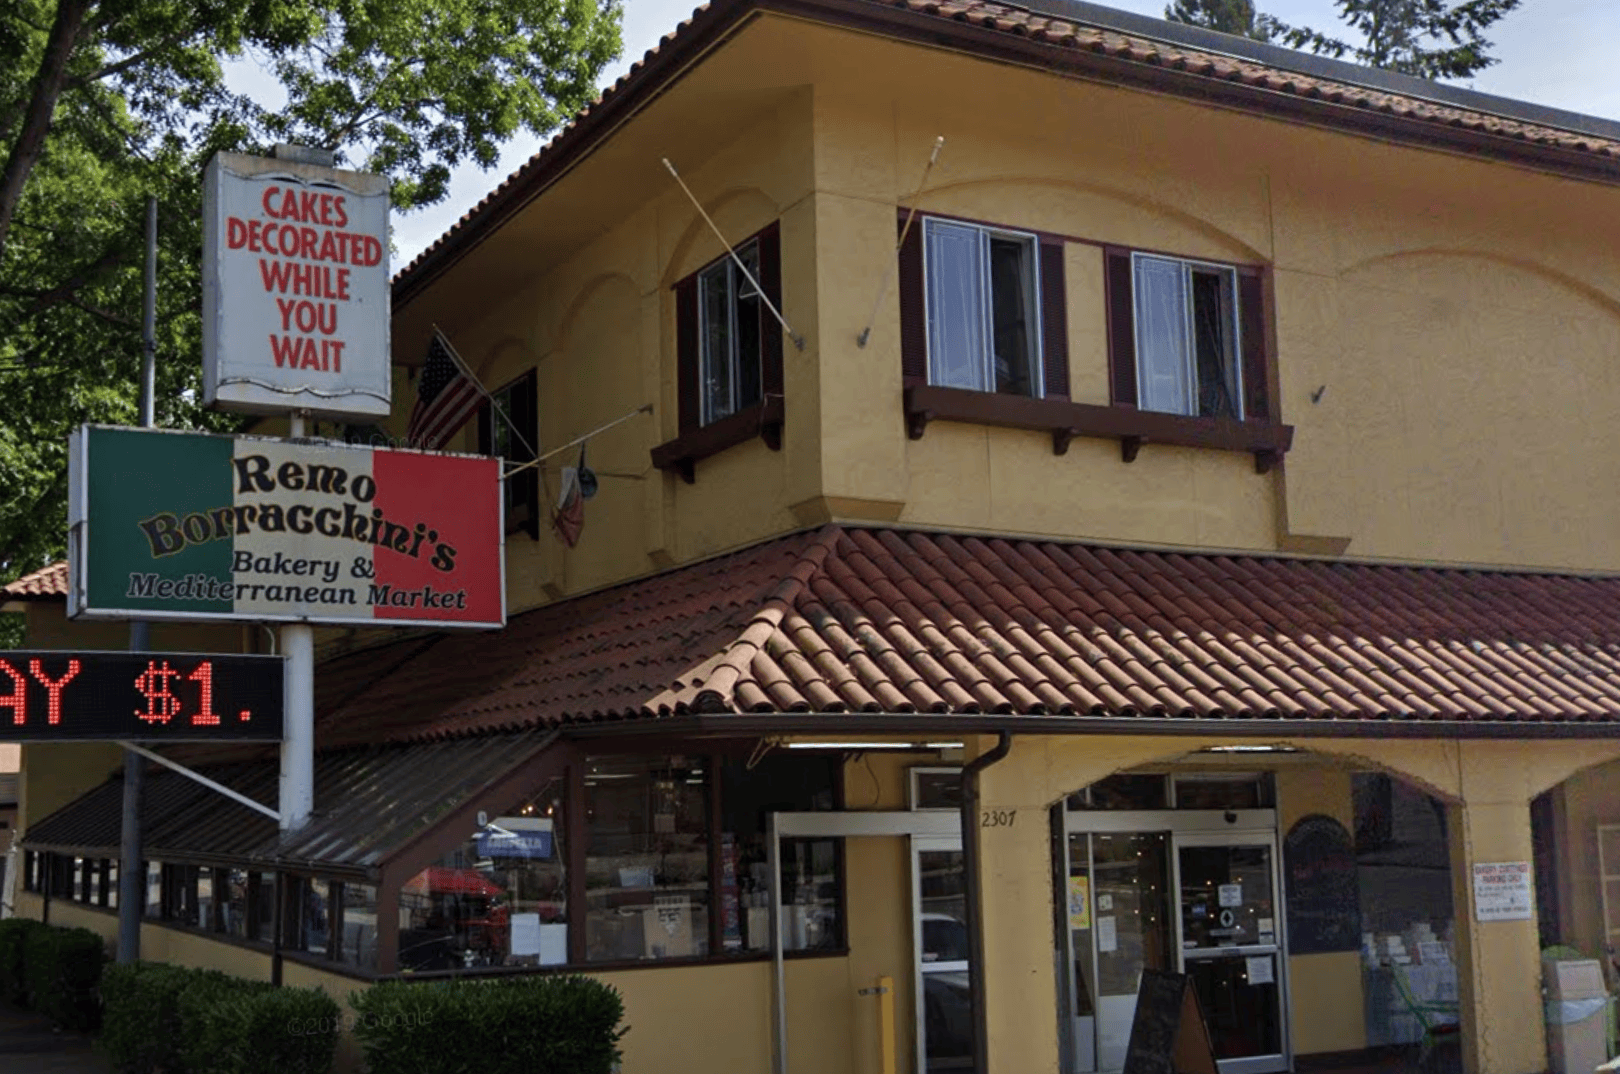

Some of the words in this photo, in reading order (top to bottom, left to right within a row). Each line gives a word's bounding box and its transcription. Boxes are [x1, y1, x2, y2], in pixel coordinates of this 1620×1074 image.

[262, 186, 349, 228] CAKES
[226, 216, 383, 267] DECORATED
[259, 258, 350, 301] WHILE
[276, 297, 337, 335] YOU
[269, 334, 346, 373] WAIT
[232, 455, 377, 502] Remo
[138, 501, 458, 572] Borracchini's
[231, 551, 341, 583] Bakery
[350, 556, 376, 579] &
[127, 573, 357, 605] Mediterranean
[366, 584, 468, 610] Market
[982, 810, 1017, 827] 2307
